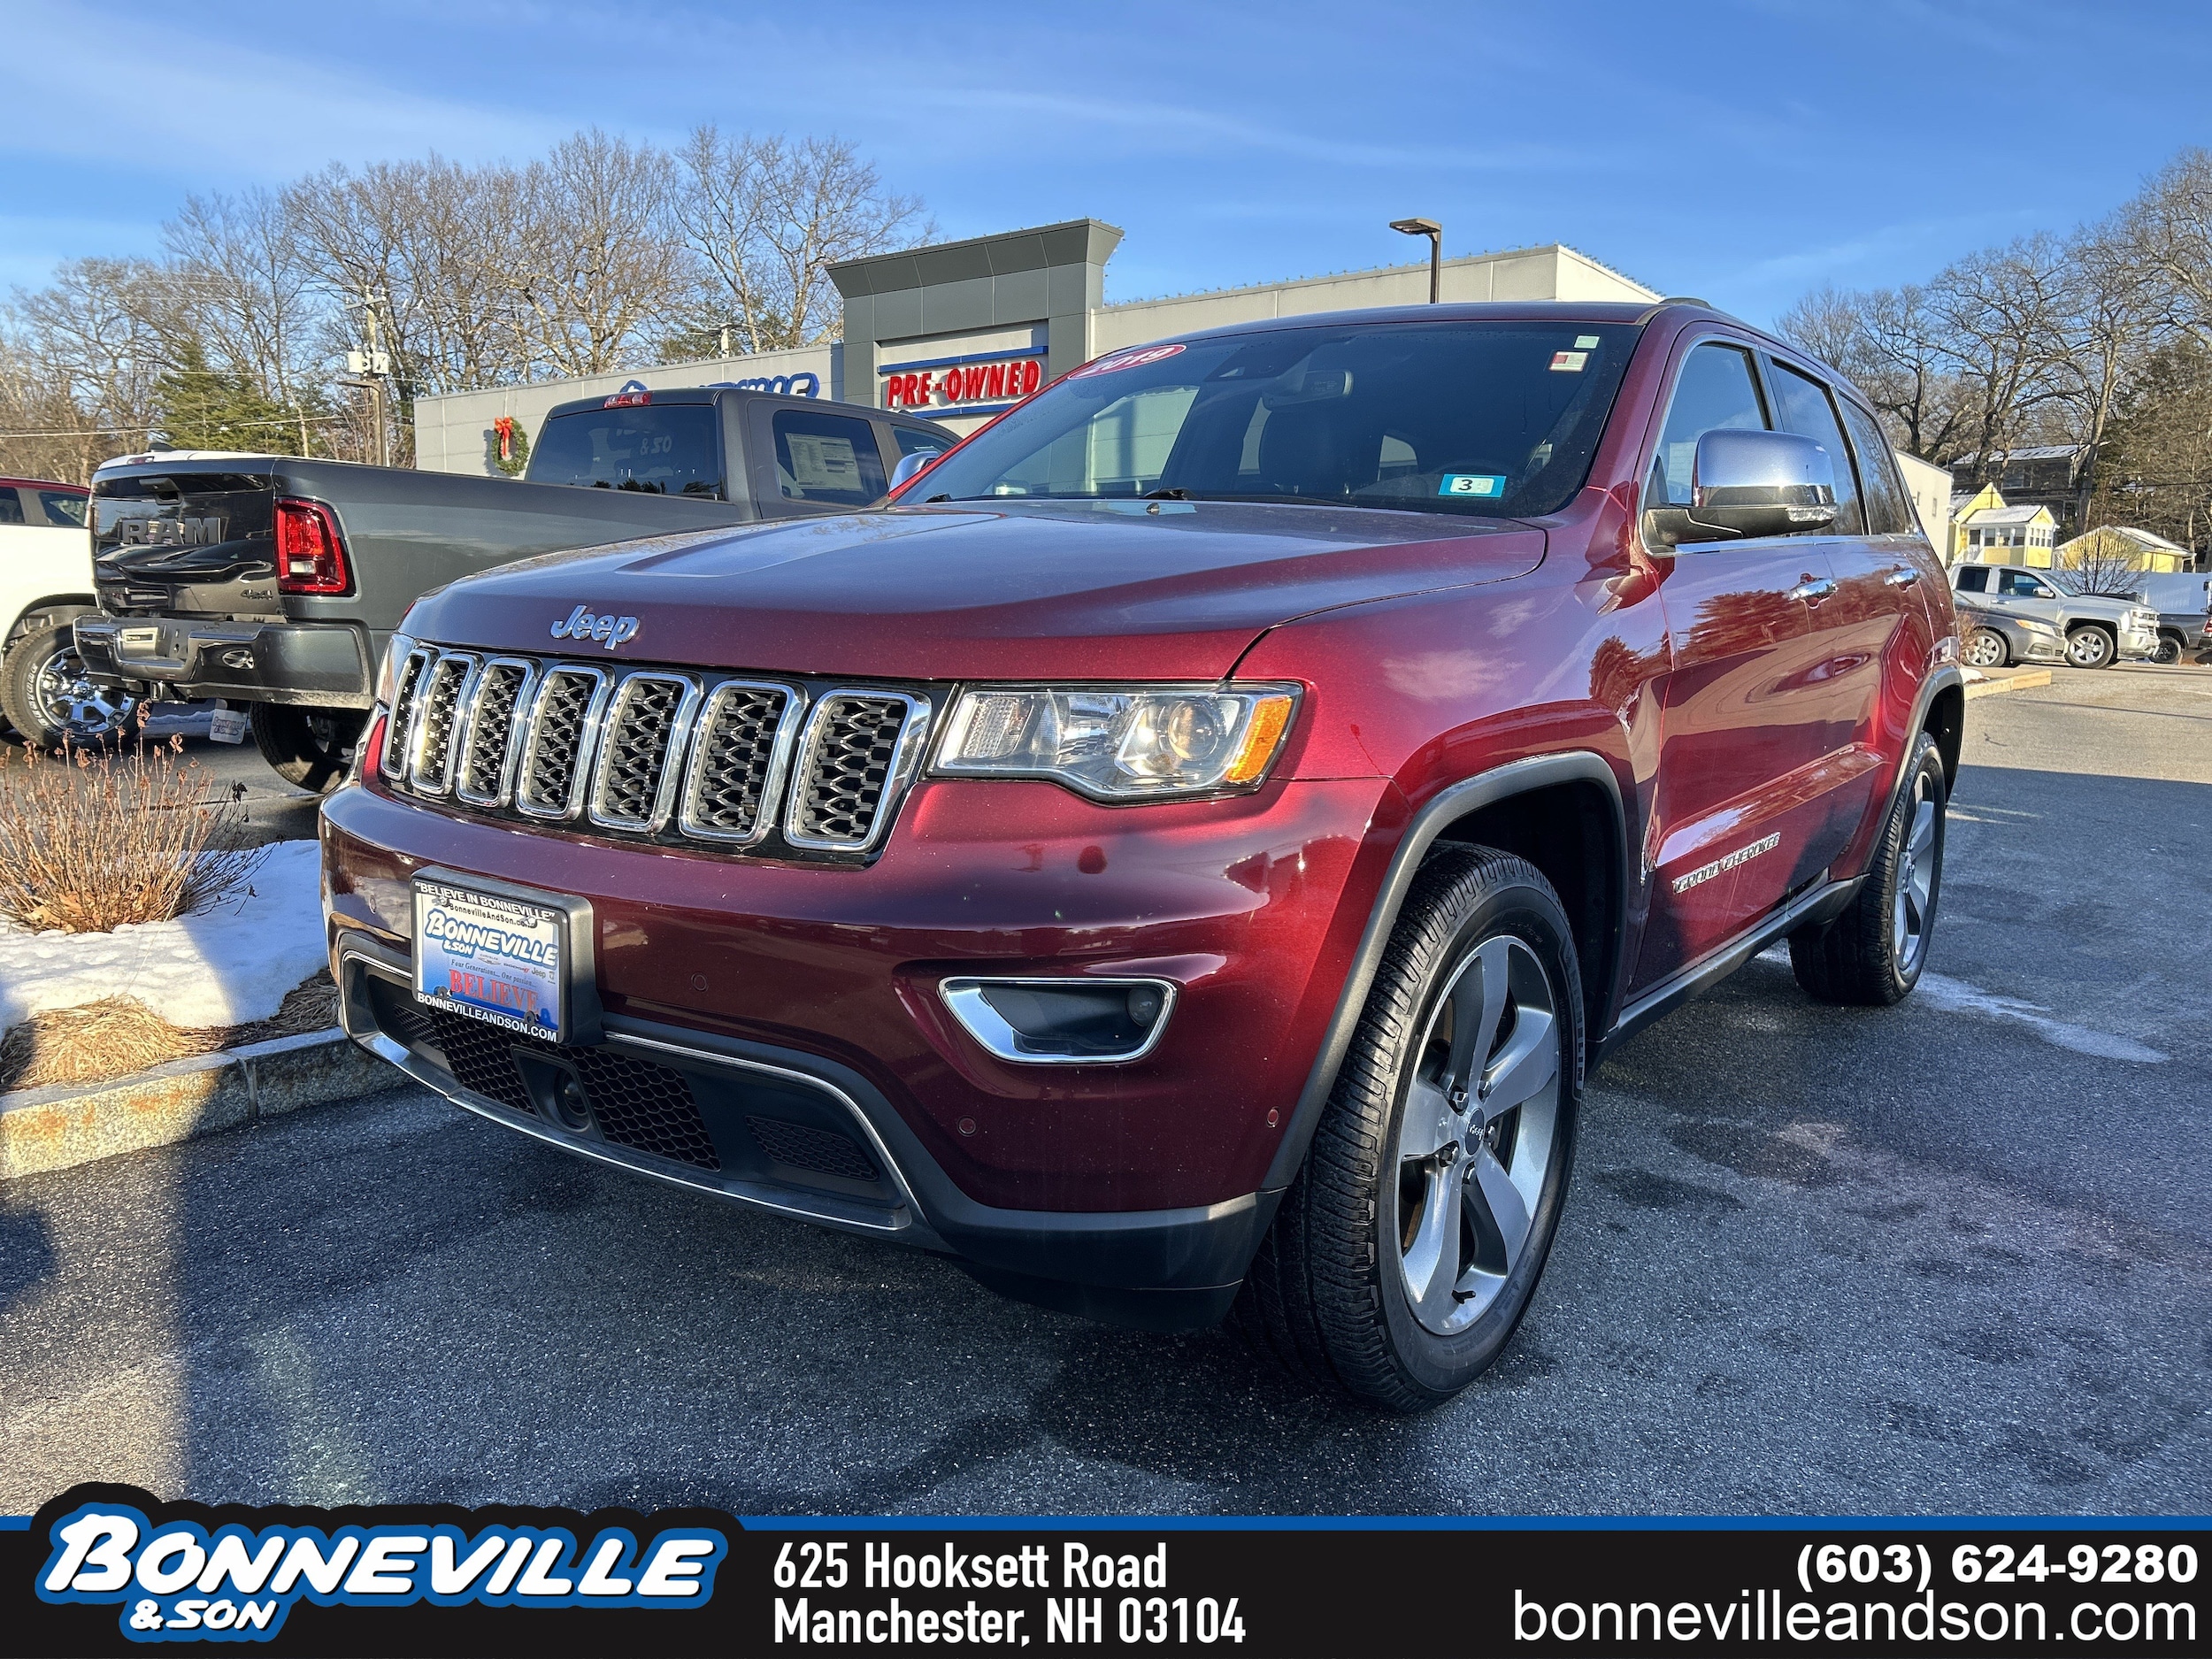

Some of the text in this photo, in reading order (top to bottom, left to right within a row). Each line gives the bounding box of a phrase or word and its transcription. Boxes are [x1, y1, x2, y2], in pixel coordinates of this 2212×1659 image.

[887, 360, 1041, 407] PRE-OWNED
[1458, 479, 1473, 491] 3
[122, 517, 221, 544] RAM
[550, 604, 641, 651] Jeep
[1671, 831, 1781, 895] GRAND CHEROKEE
[449, 902, 534, 928] BonnevilleAndSon.co
[466, 893, 479, 904] IN
[426, 910, 557, 966] BONNEVILLE
[449, 969, 540, 1014] BELIEVE
[451, 958, 464, 968] Four
[501, 972, 511, 980] One
[417, 992, 557, 1043] BONNEVILLEANDSON.COM
